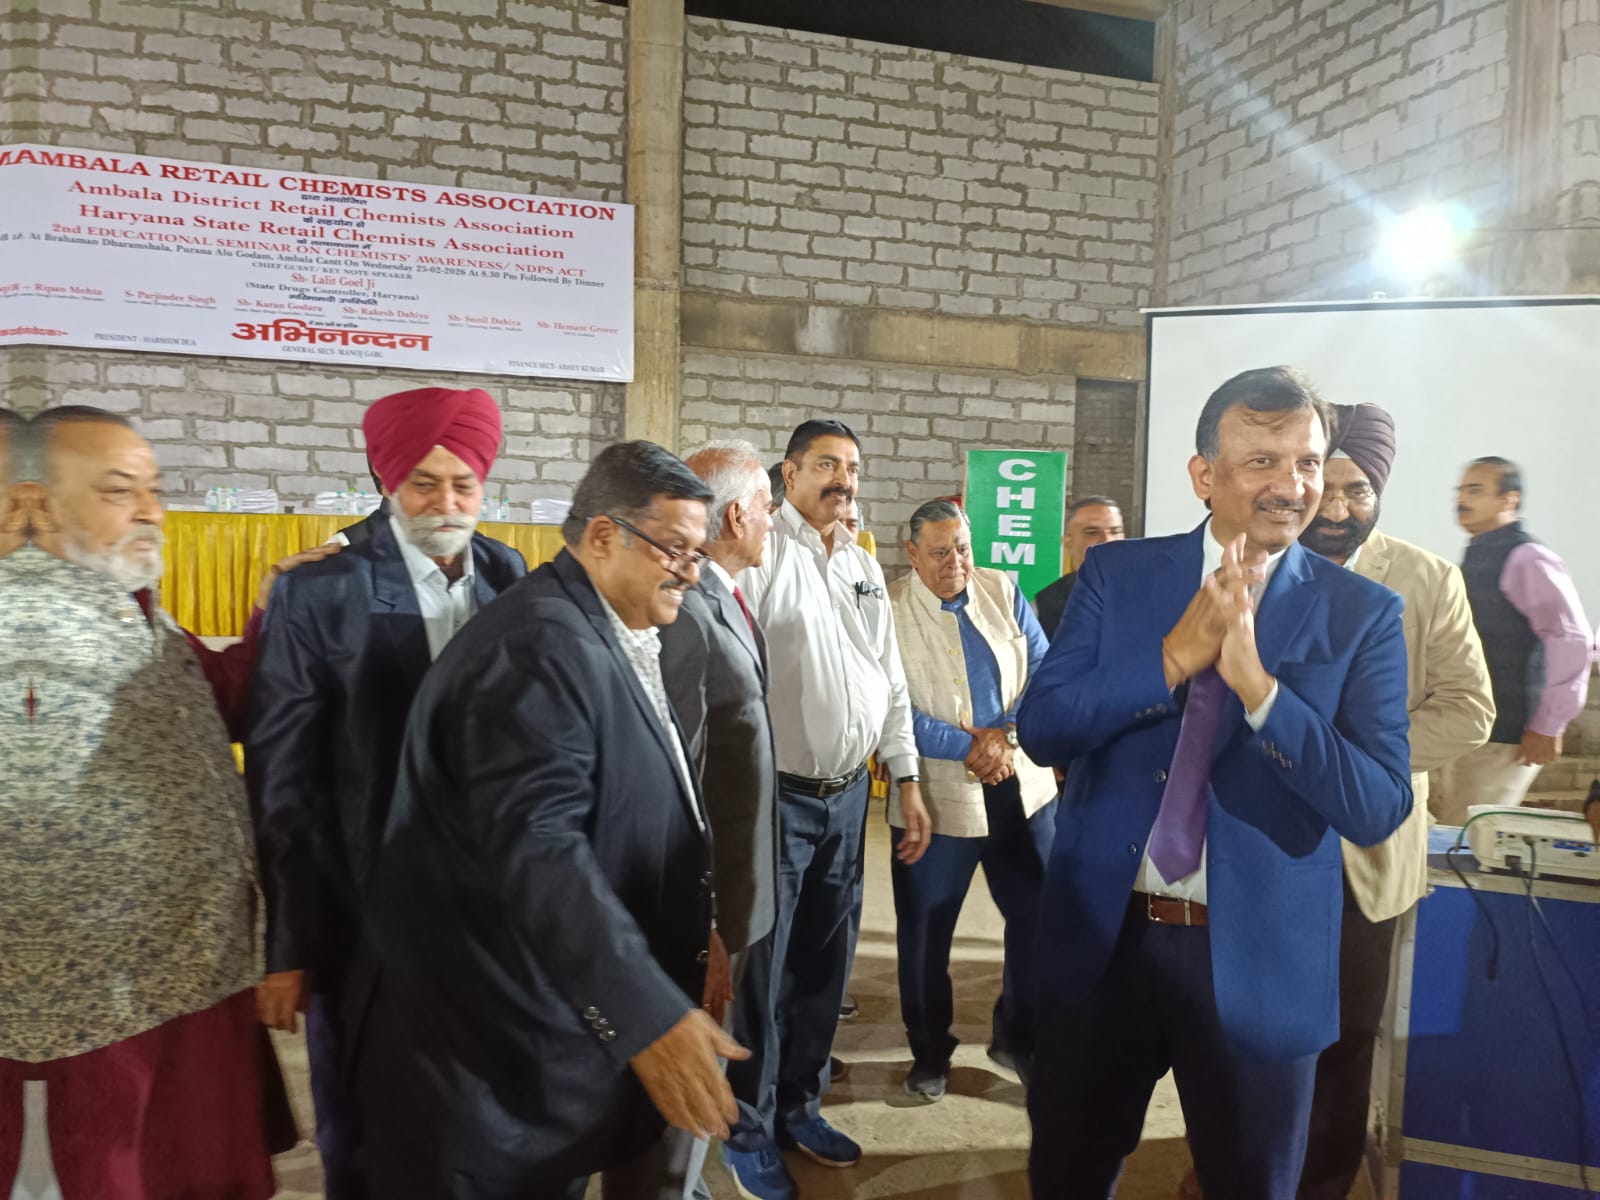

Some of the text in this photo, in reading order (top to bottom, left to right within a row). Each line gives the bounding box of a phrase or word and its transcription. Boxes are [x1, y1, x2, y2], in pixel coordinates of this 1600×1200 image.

[68, 180, 574, 239] Ambala District Retail Chemists Association
[160, 164, 270, 188] RETAIL
[279, 176, 427, 204] CHEMISTS
[435, 191, 616, 221] ASSOCIATION
[52, 223, 81, 234] 2nd
[87, 226, 212, 246] EDUCATIONAL
[216, 238, 291, 253] SEMINAR
[296, 245, 320, 255] ON
[515, 263, 554, 275] NDPS
[558, 267, 587, 277] ACT
[80, 204, 565, 259] Haryana State Retail Chemists Association
[176, 244, 212, 256] Purana
[277, 253, 313, 264] Ambala
[316, 257, 341, 266] Cantt
[344, 259, 359, 267] On
[362, 260, 413, 272] Wednesday
[416, 265, 466, 277] 25-02-2026
[468, 269, 479, 277] At
[520, 273, 559, 284] Followed
[562, 277, 572, 287] By
[252, 261, 281, 270] CHIEF
[312, 274, 336, 286] Lalit
[339, 276, 363, 288] Goel
[231, 318, 432, 352] अभिनन्दन
